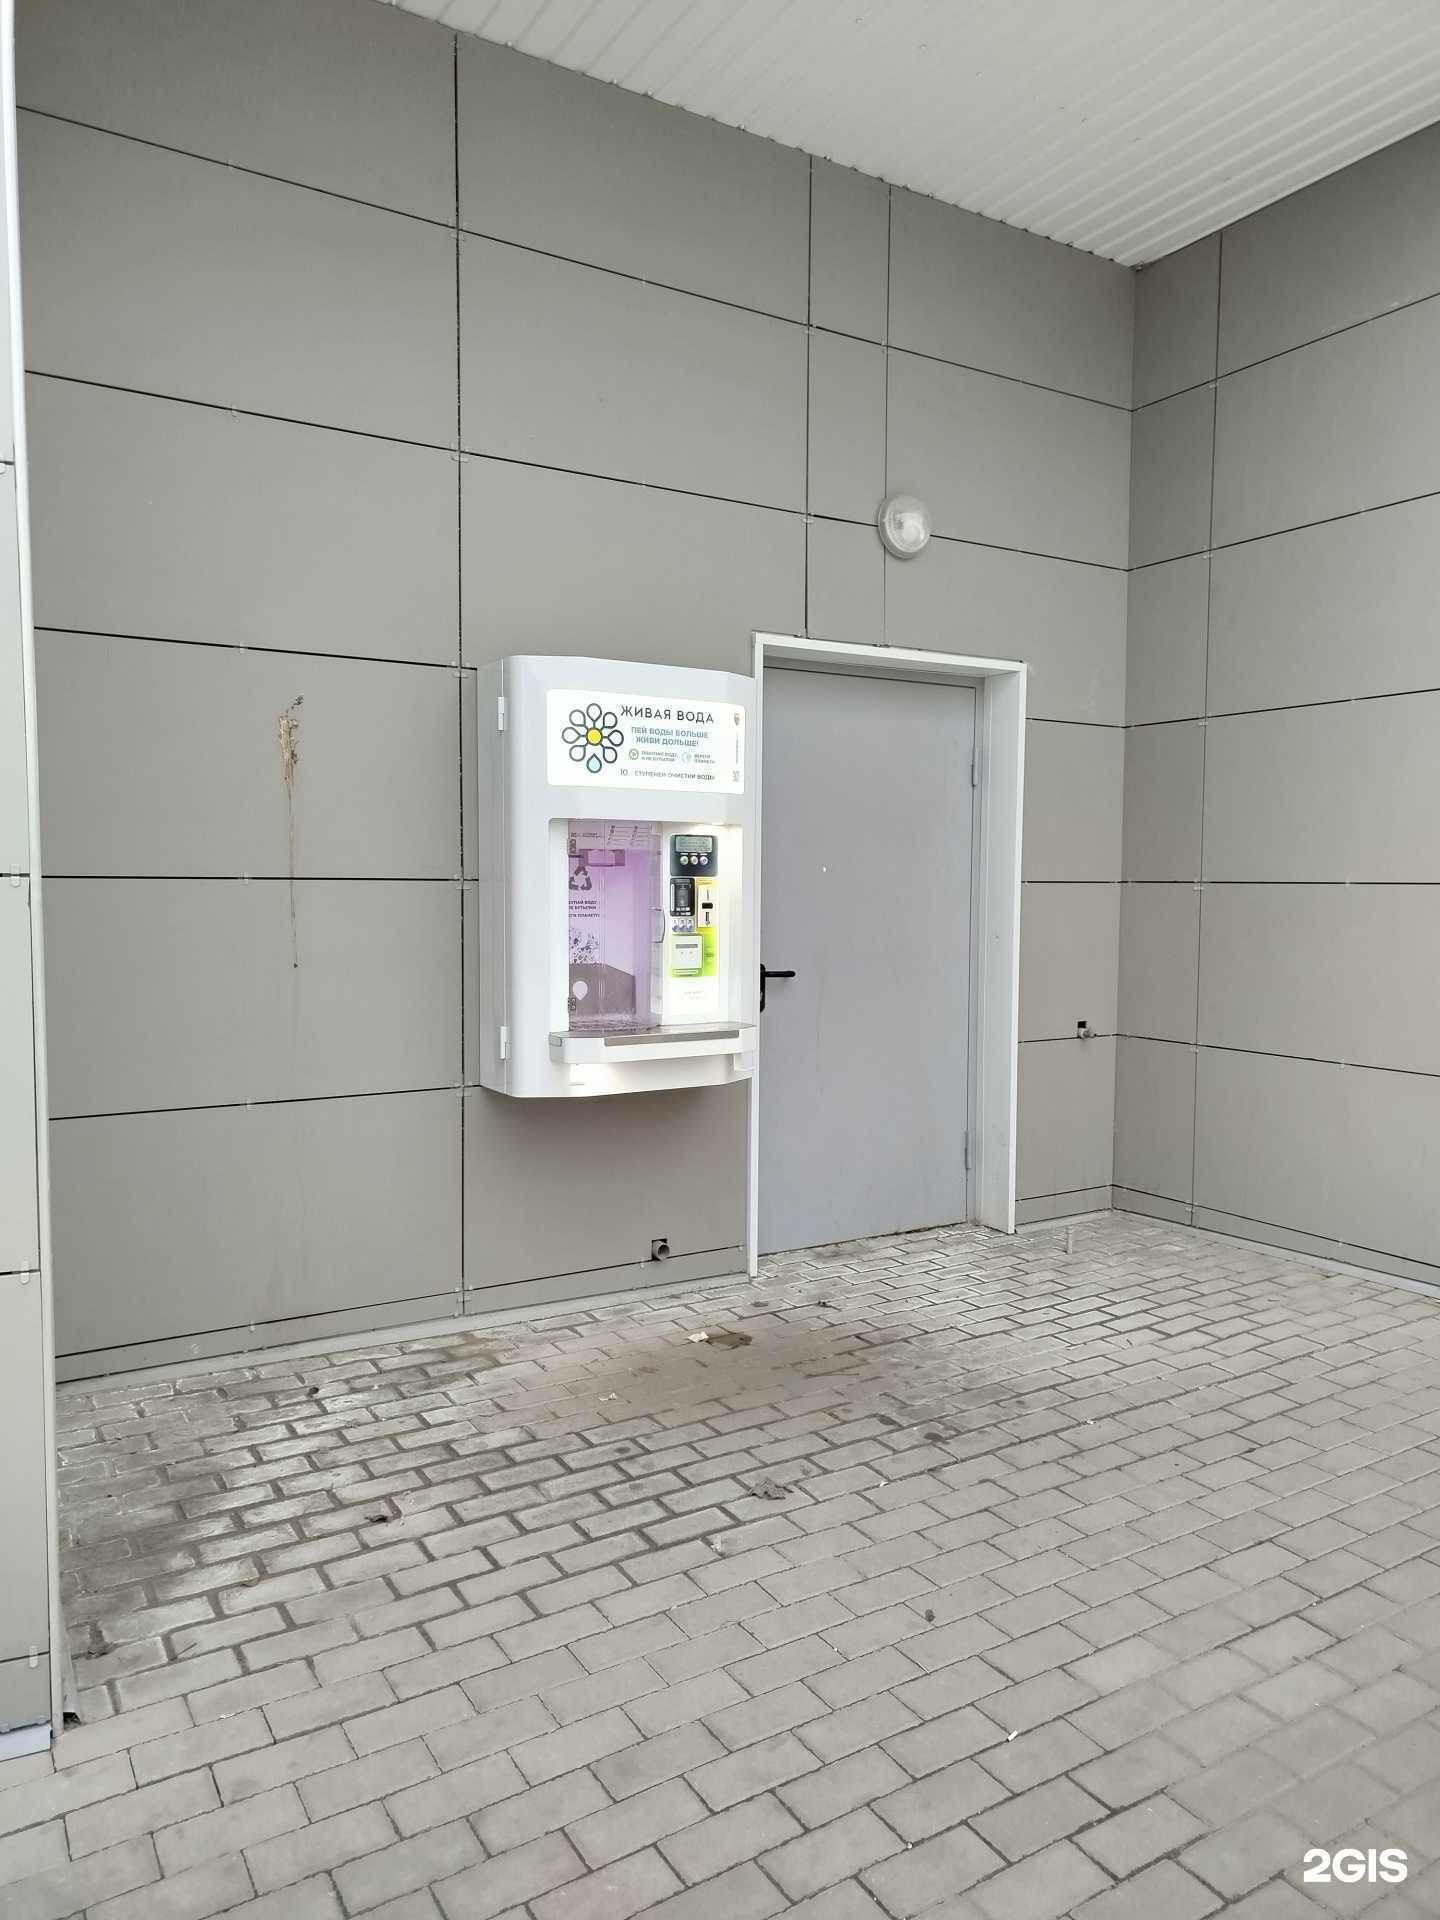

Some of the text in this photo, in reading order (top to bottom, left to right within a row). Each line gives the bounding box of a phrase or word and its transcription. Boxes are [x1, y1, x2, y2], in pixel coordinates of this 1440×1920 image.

[620, 705, 714, 724] ЖИВАЯ ВОДА
[631, 726, 647, 734] ПЕЙ
[649, 728, 674, 736] ВОДЫ
[636, 736, 660, 744] ЖИВИ
